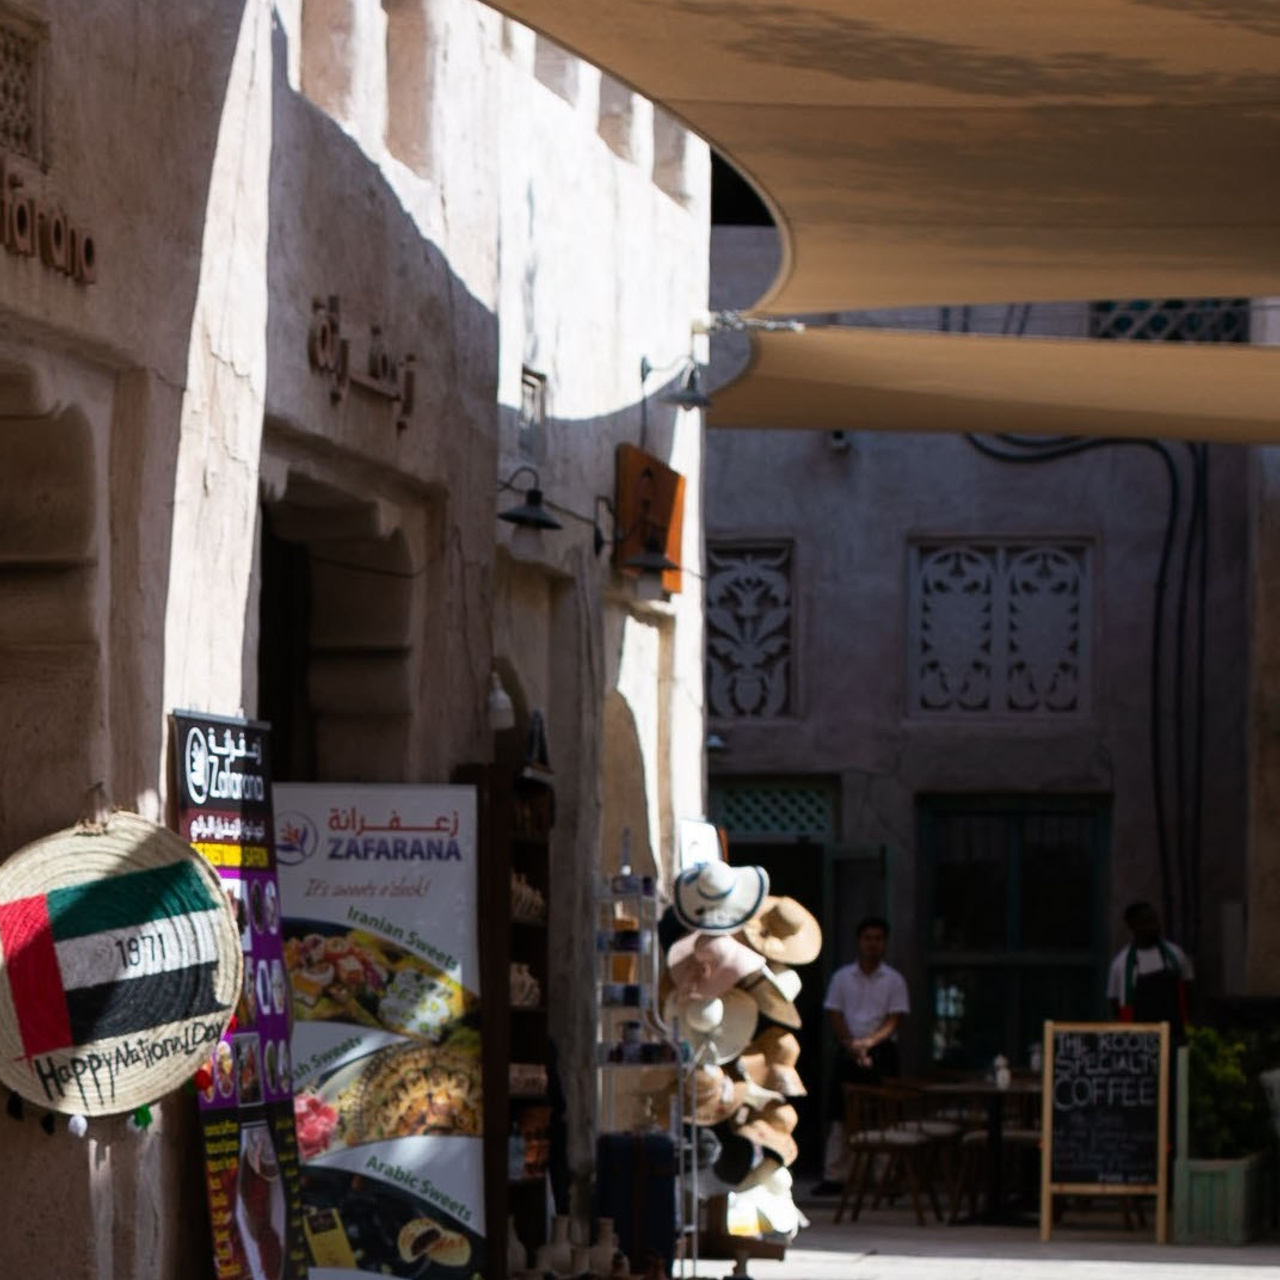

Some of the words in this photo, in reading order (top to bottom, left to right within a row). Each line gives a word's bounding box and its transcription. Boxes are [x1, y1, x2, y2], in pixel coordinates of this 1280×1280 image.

[328, 838, 461, 861] ZAFARANA
[115, 933, 166, 969] 1971
[347, 905, 404, 939] Iranian
[407, 930, 459, 970] Sweets
[310, 1035, 363, 1067] Sweets
[1054, 1075, 1157, 1111] COFFEE
[366, 1155, 418, 1189] Arabic
[419, 1177, 474, 1222] Sweets
